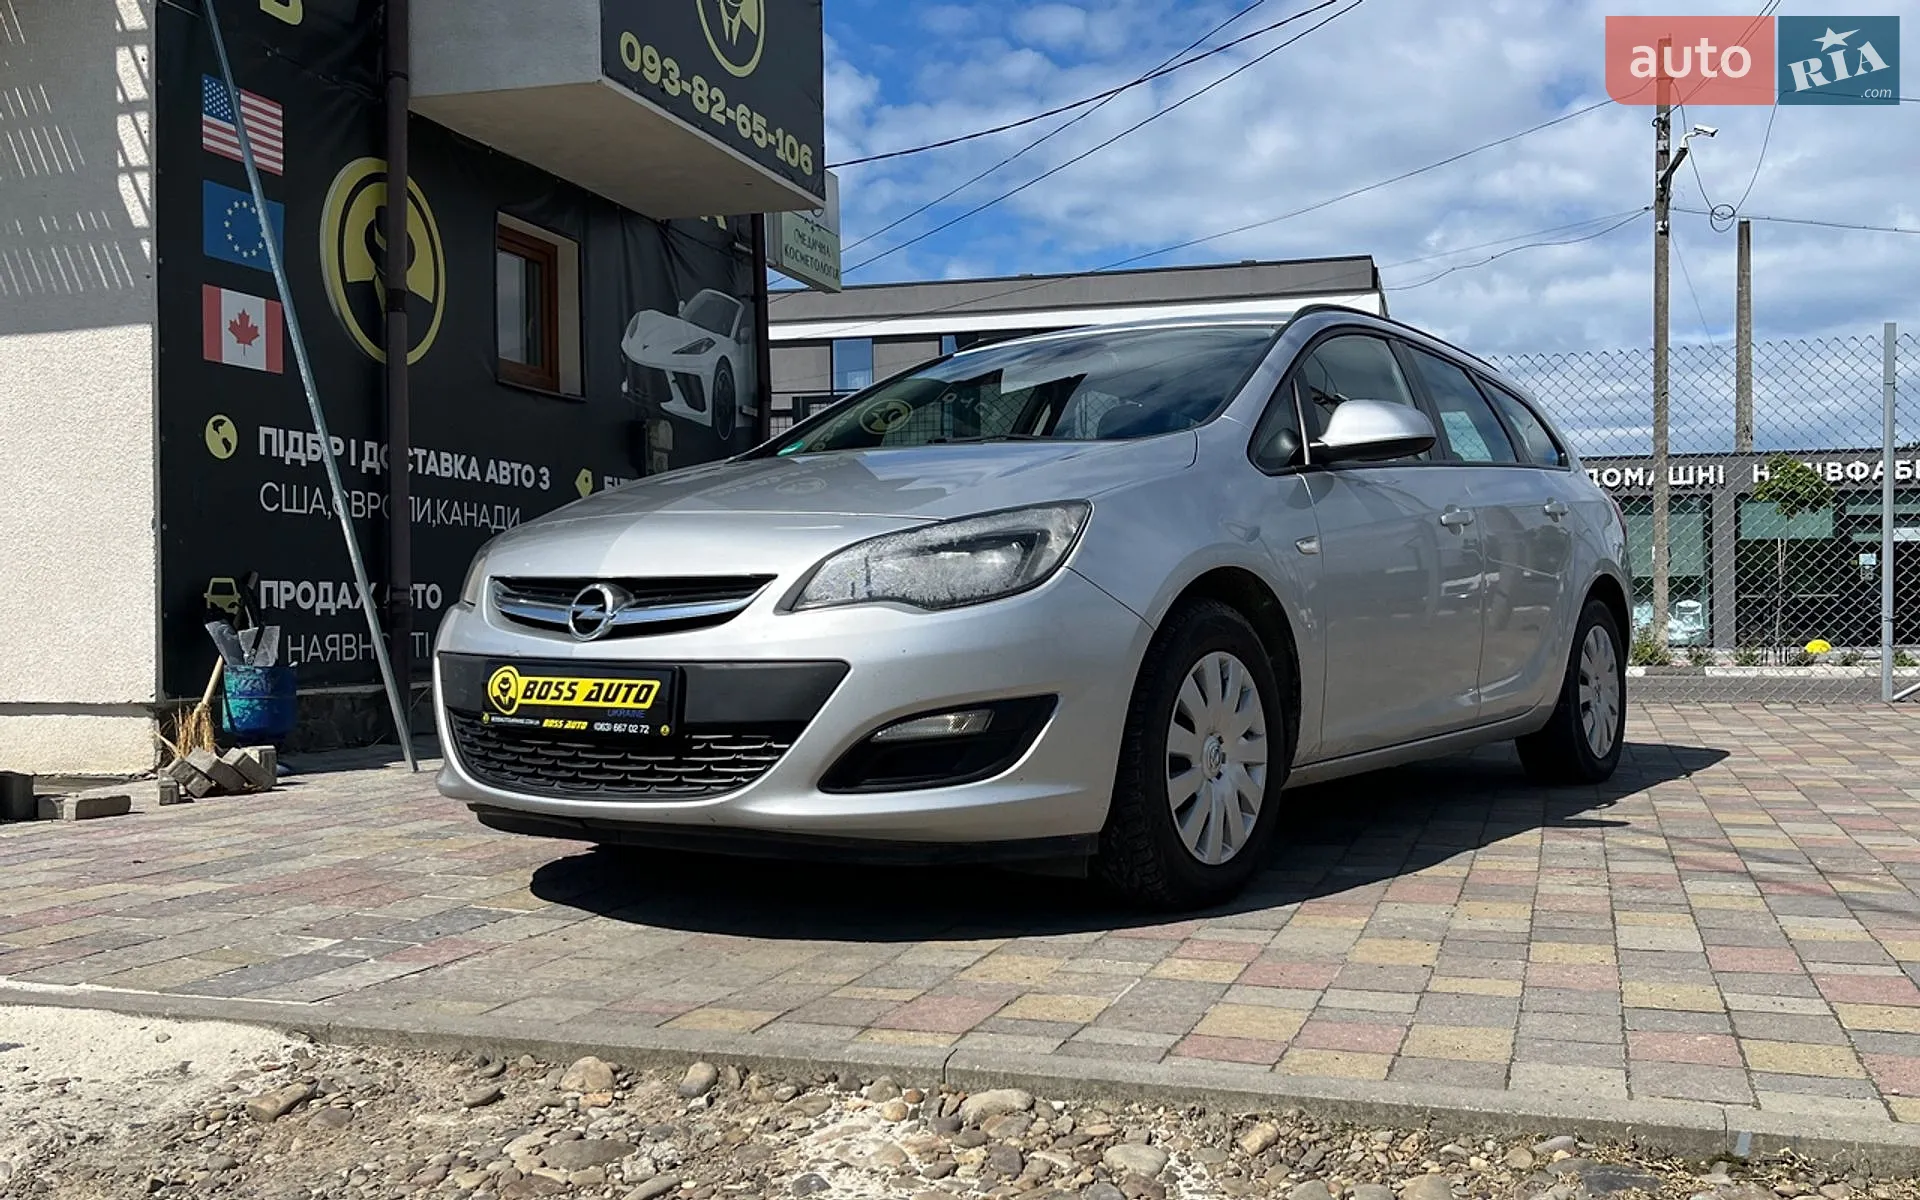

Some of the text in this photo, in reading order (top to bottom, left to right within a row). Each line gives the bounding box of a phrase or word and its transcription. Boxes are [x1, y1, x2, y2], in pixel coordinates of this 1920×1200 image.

[619, 31, 814, 176] 093-82-65-106
[259, 426, 345, 467] ПІДБР
[485, 459, 536, 489] АВТО
[1585, 464, 1725, 488] ДОМШНІ
[383, 583, 442, 610] ТО
[287, 631, 429, 663] НАЯВНТІ
[521, 679, 655, 705] BOSS AUTO
[542, 718, 565, 728] BOSS
[564, 720, 588, 731] AUTO
[640, 724, 650, 735] 72
